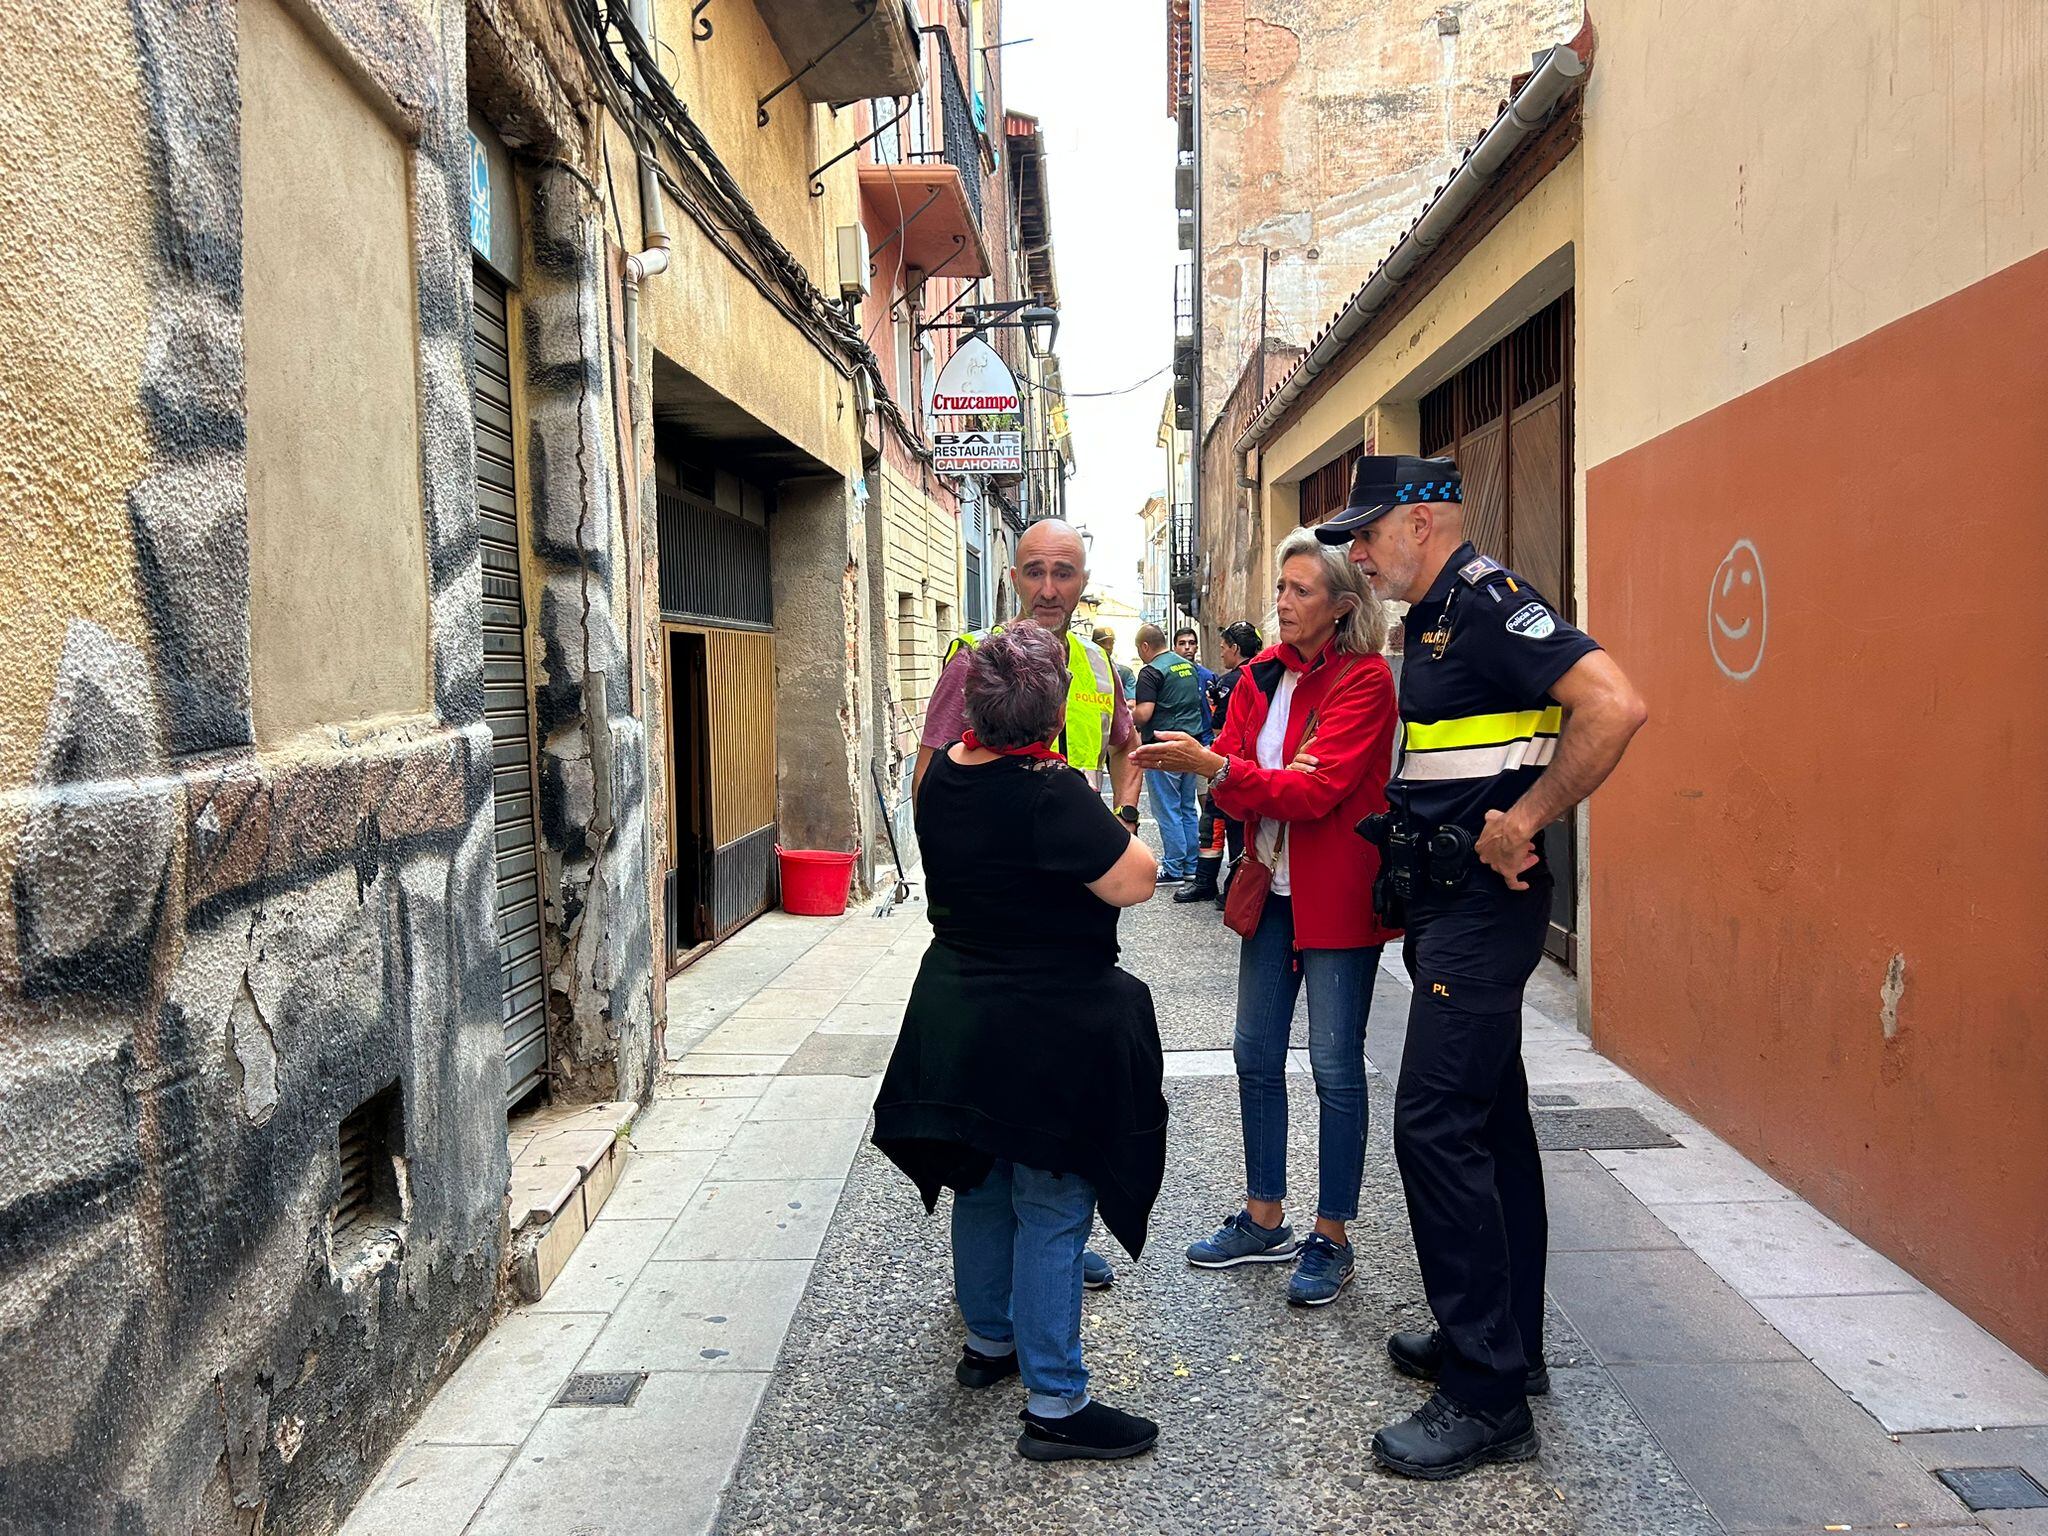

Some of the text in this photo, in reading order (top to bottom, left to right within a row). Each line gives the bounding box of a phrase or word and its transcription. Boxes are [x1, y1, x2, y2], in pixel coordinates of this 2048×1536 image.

[933, 394, 1018, 412] Cruzcampo
[934, 434, 1020, 445] BAR
[934, 446, 1020, 457] RESTAURANTE
[936, 459, 1019, 470] CALAHORRA
[1433, 983, 1450, 997] PL
